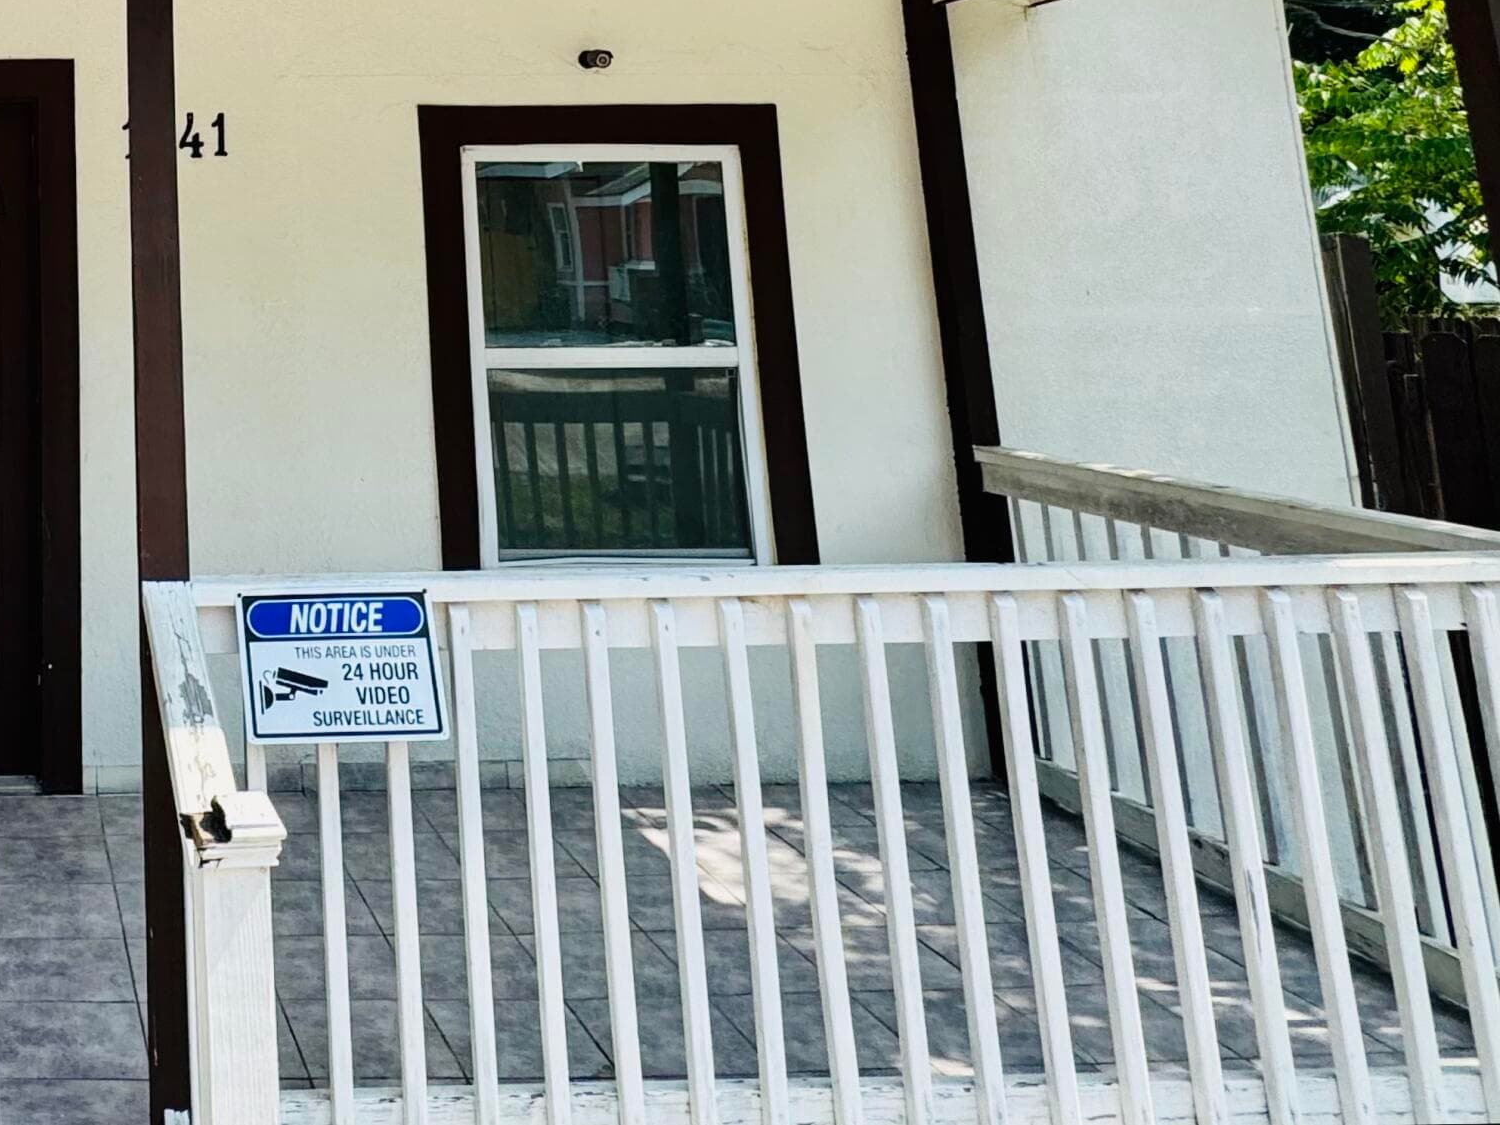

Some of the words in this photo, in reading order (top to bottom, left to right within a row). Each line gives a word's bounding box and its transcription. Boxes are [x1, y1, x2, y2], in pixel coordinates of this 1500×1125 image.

[122, 112, 228, 158] 41
[289, 602, 384, 634] NOTICE
[295, 646, 322, 659] THIS
[325, 646, 357, 659] AREA
[361, 645, 372, 658] IS
[375, 644, 417, 658] UNDER
[341, 663, 364, 681] 24
[369, 662, 419, 681] HOUR
[356, 686, 410, 705] VIDEO
[313, 709, 425, 727] SURVEILLANCE
